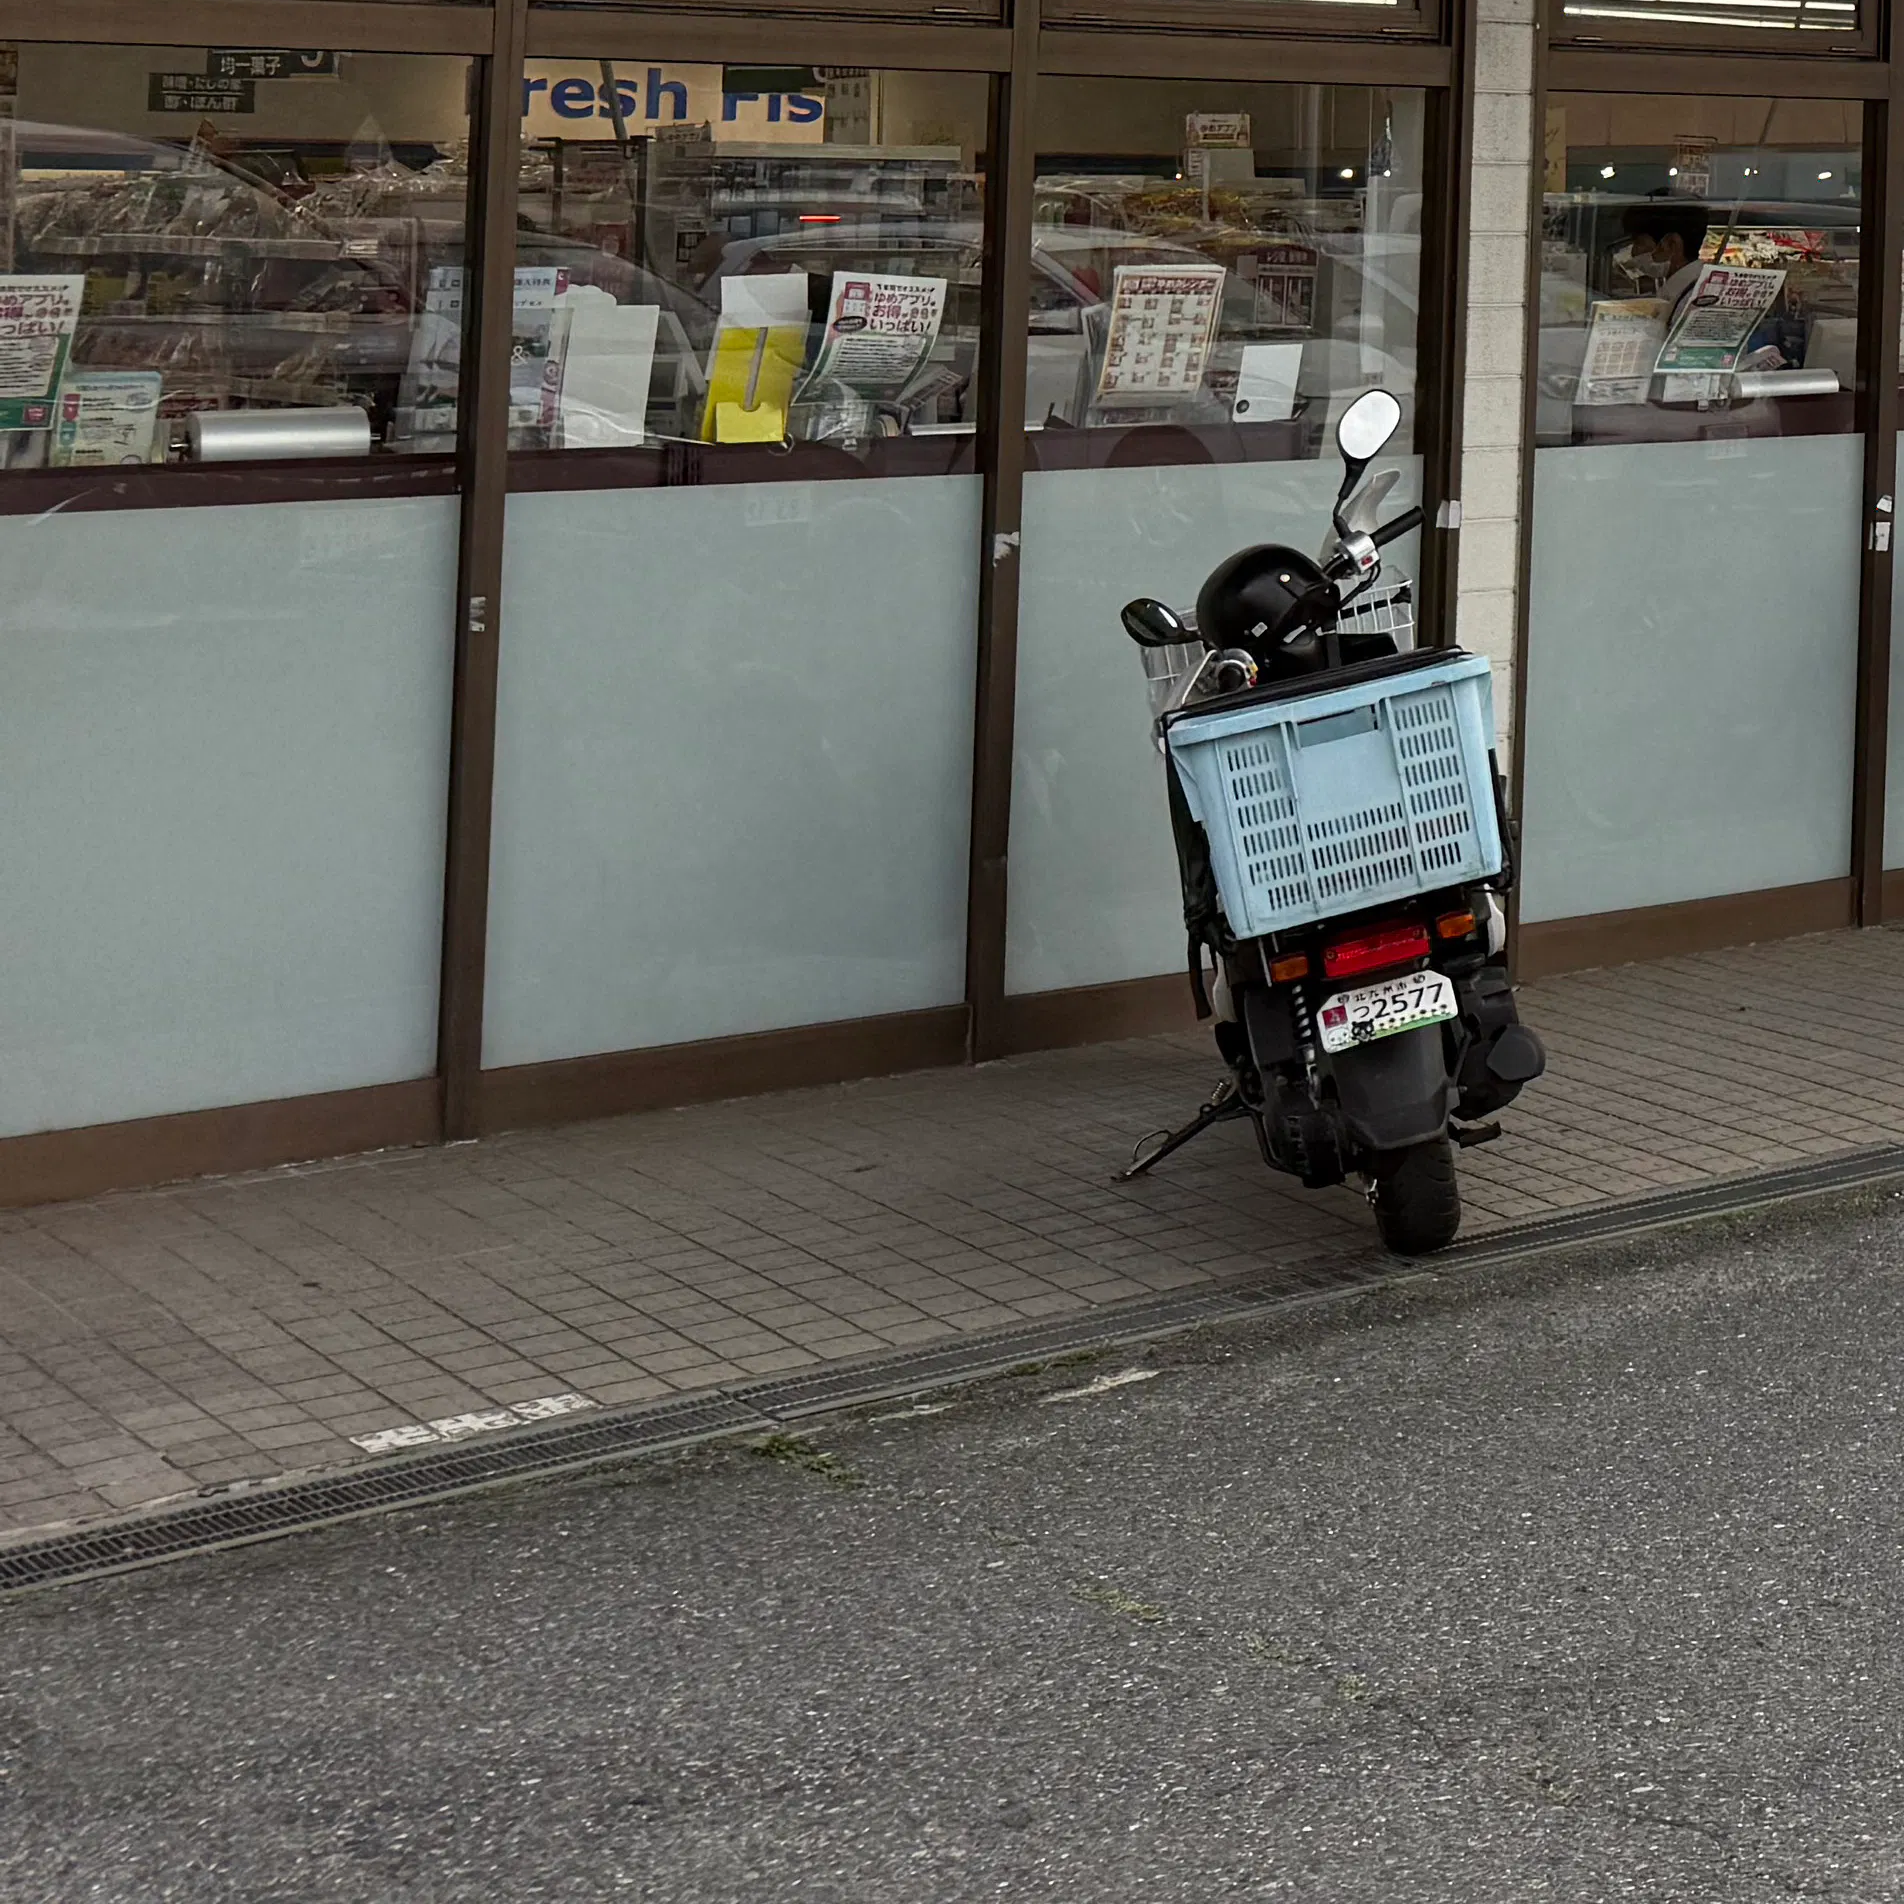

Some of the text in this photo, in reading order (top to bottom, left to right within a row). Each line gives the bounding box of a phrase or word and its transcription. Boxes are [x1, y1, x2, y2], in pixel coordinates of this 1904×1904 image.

[523, 68, 824, 123] resh Fis
[1352, 982, 1444, 1019] つ 2577
[1354, 982, 1408, 1002] 北九州市
